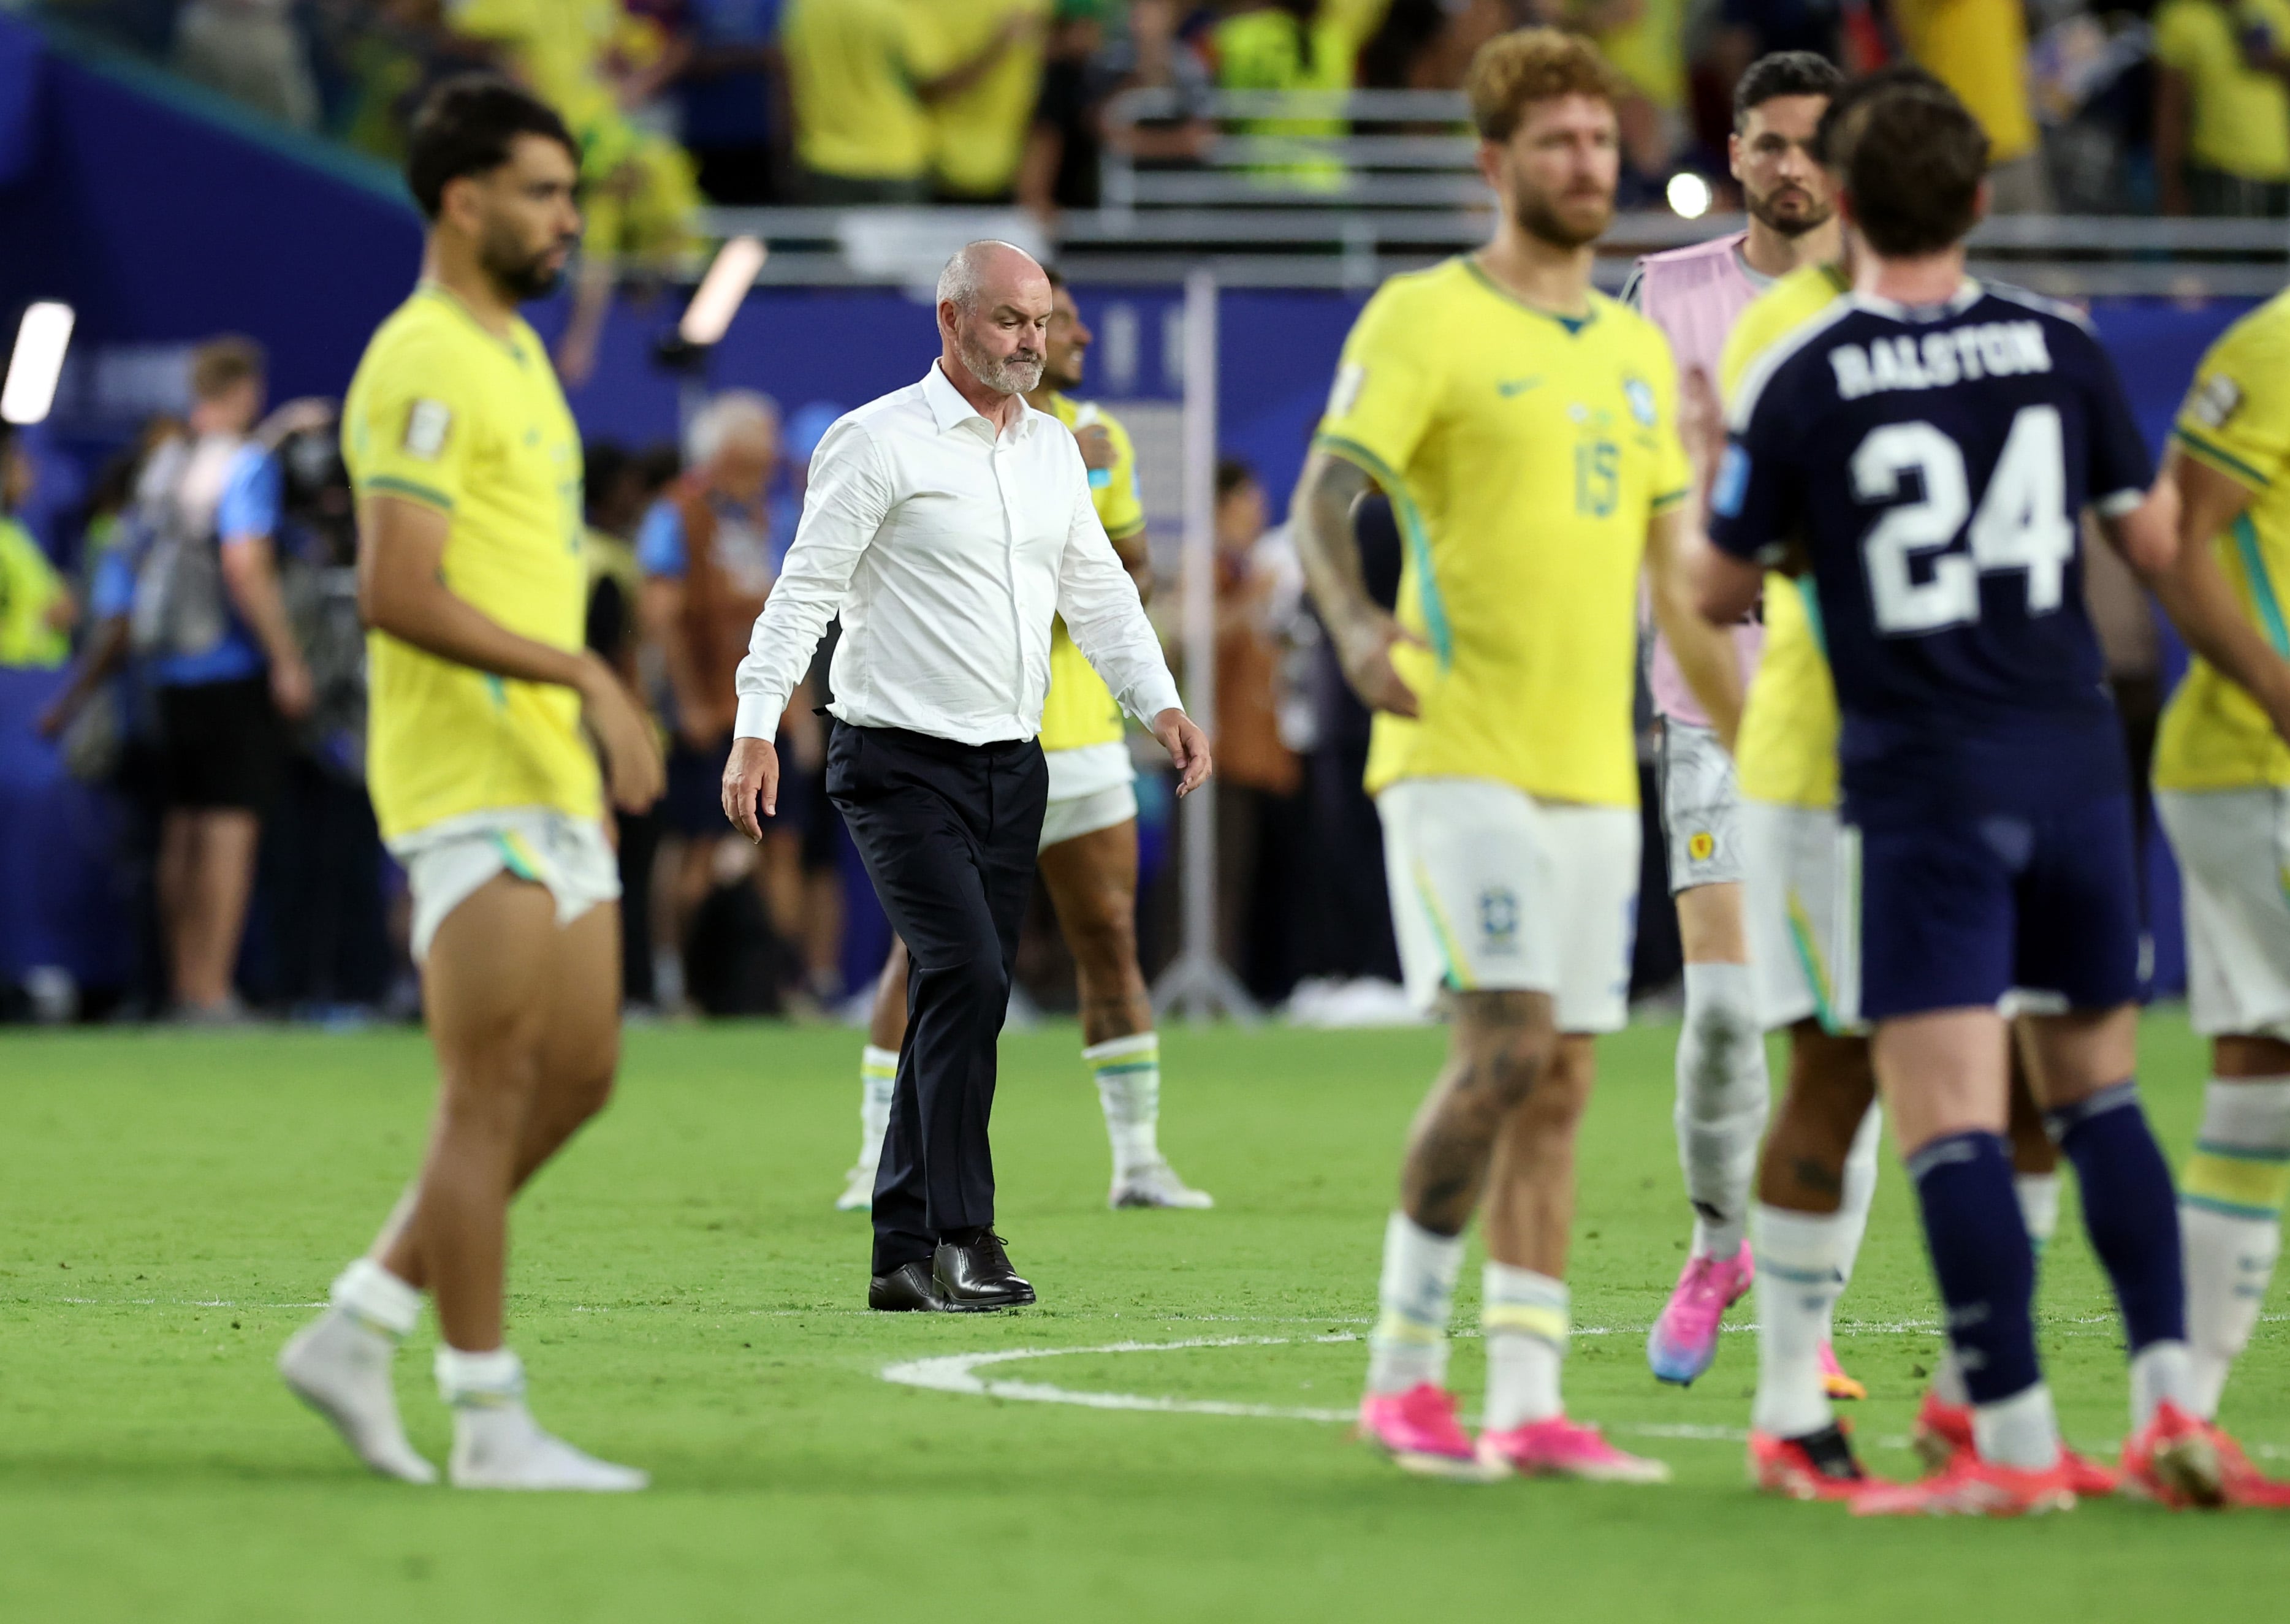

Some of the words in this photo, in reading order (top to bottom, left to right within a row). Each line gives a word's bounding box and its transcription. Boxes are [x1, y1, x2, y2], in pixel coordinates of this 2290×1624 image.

[1828, 320, 2052, 400] RALSTON
[1575, 441, 1619, 516] 15
[1852, 403, 2074, 635] 24
